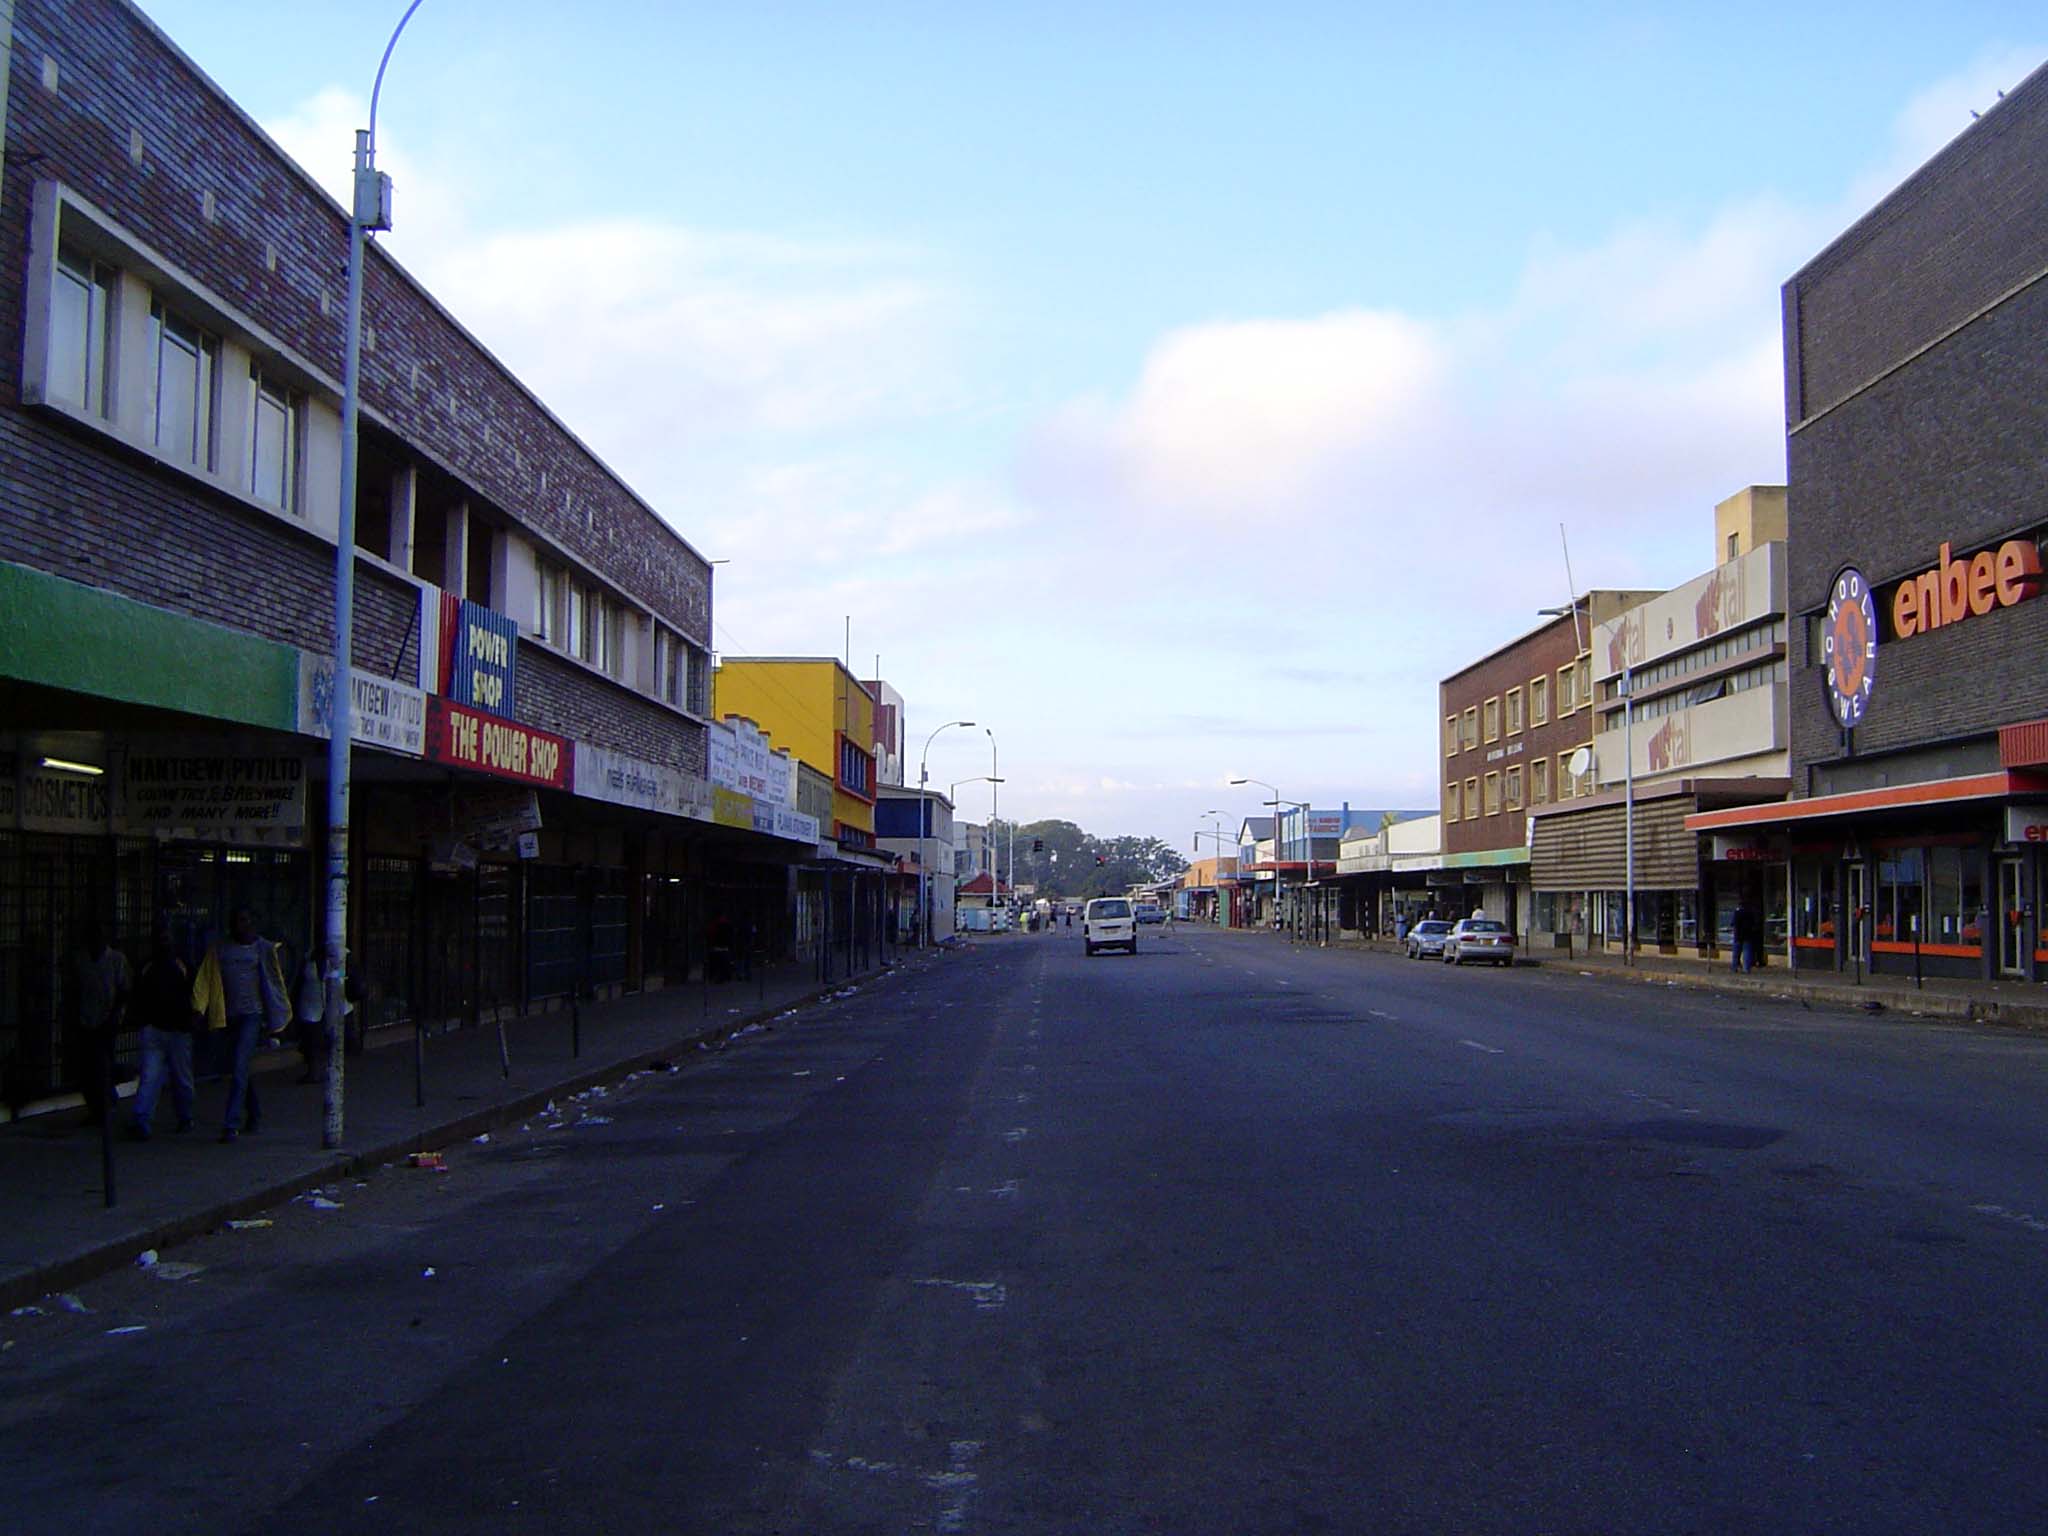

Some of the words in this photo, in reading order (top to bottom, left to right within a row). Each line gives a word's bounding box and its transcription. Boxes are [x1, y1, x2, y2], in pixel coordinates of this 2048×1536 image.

[1894, 540, 2041, 639] enbee
[468, 623, 508, 668] POWER
[473, 669, 503, 708] SHOP
[1841, 641, 1875, 720] WEAR
[450, 711, 479, 762] THE
[482, 722, 527, 774] POWER
[530, 736, 560, 780] SHOP
[143, 805, 173, 820] AND
[181, 806, 228, 821] MANY
